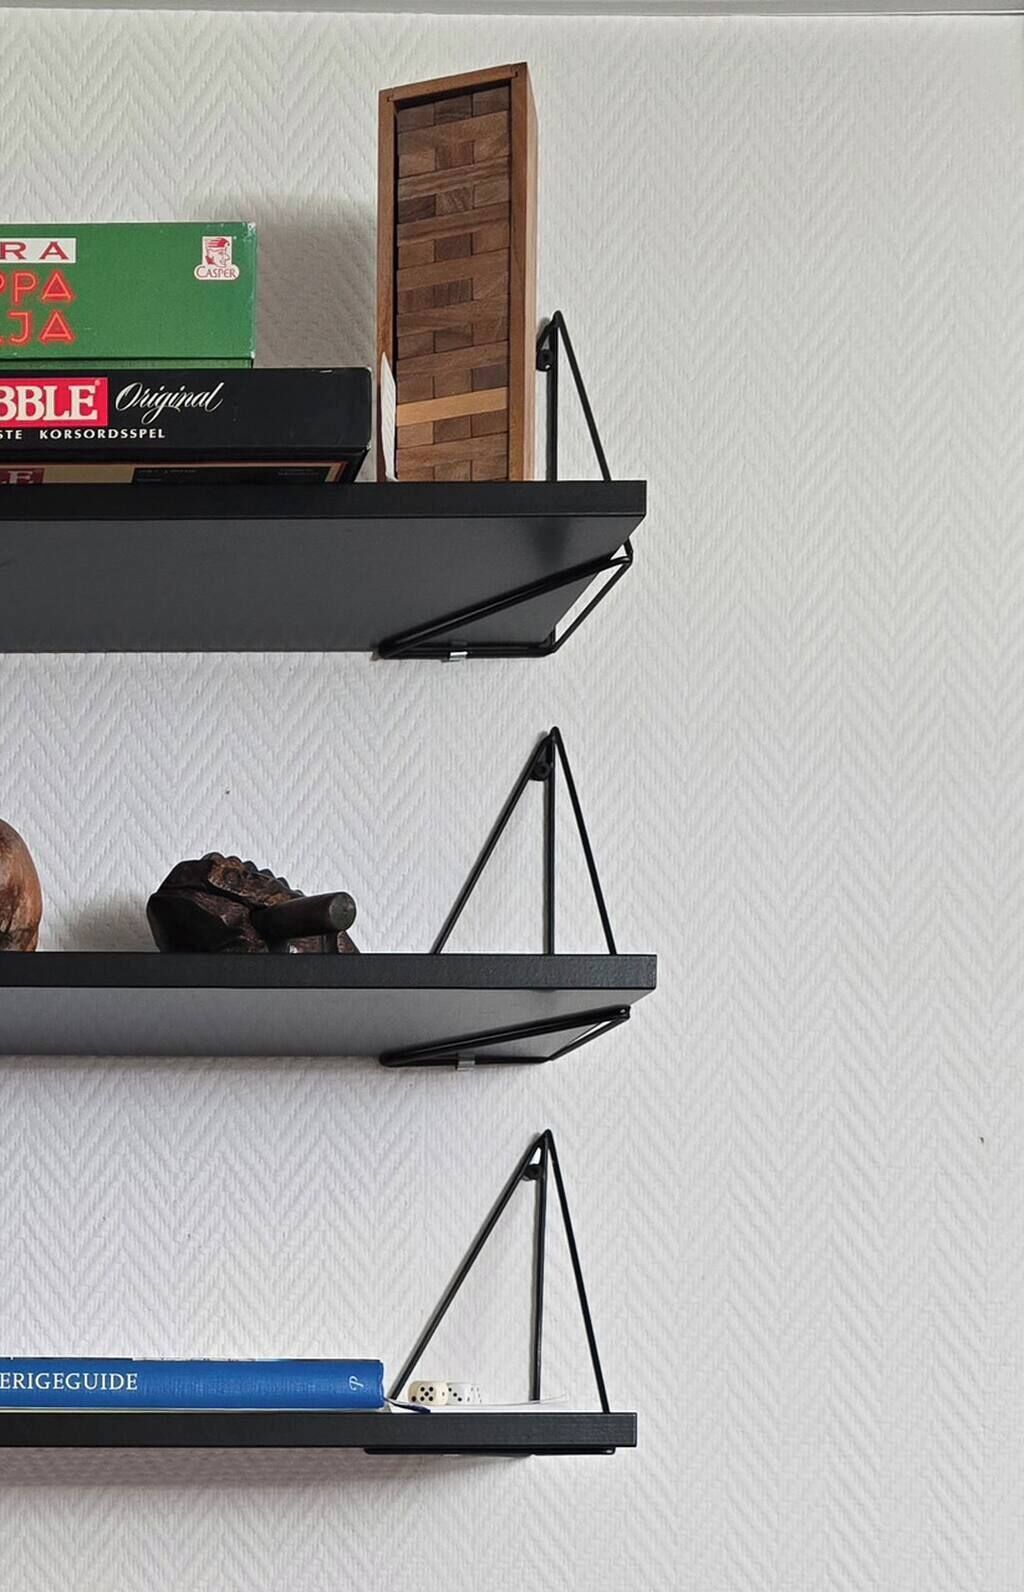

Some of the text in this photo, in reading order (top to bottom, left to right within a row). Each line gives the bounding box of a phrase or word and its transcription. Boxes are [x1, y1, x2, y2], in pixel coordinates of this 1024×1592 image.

[196, 265, 237, 279] CASPER
[115, 381, 225, 425] Original
[39, 428, 166, 441] KORSORDSSPEL
